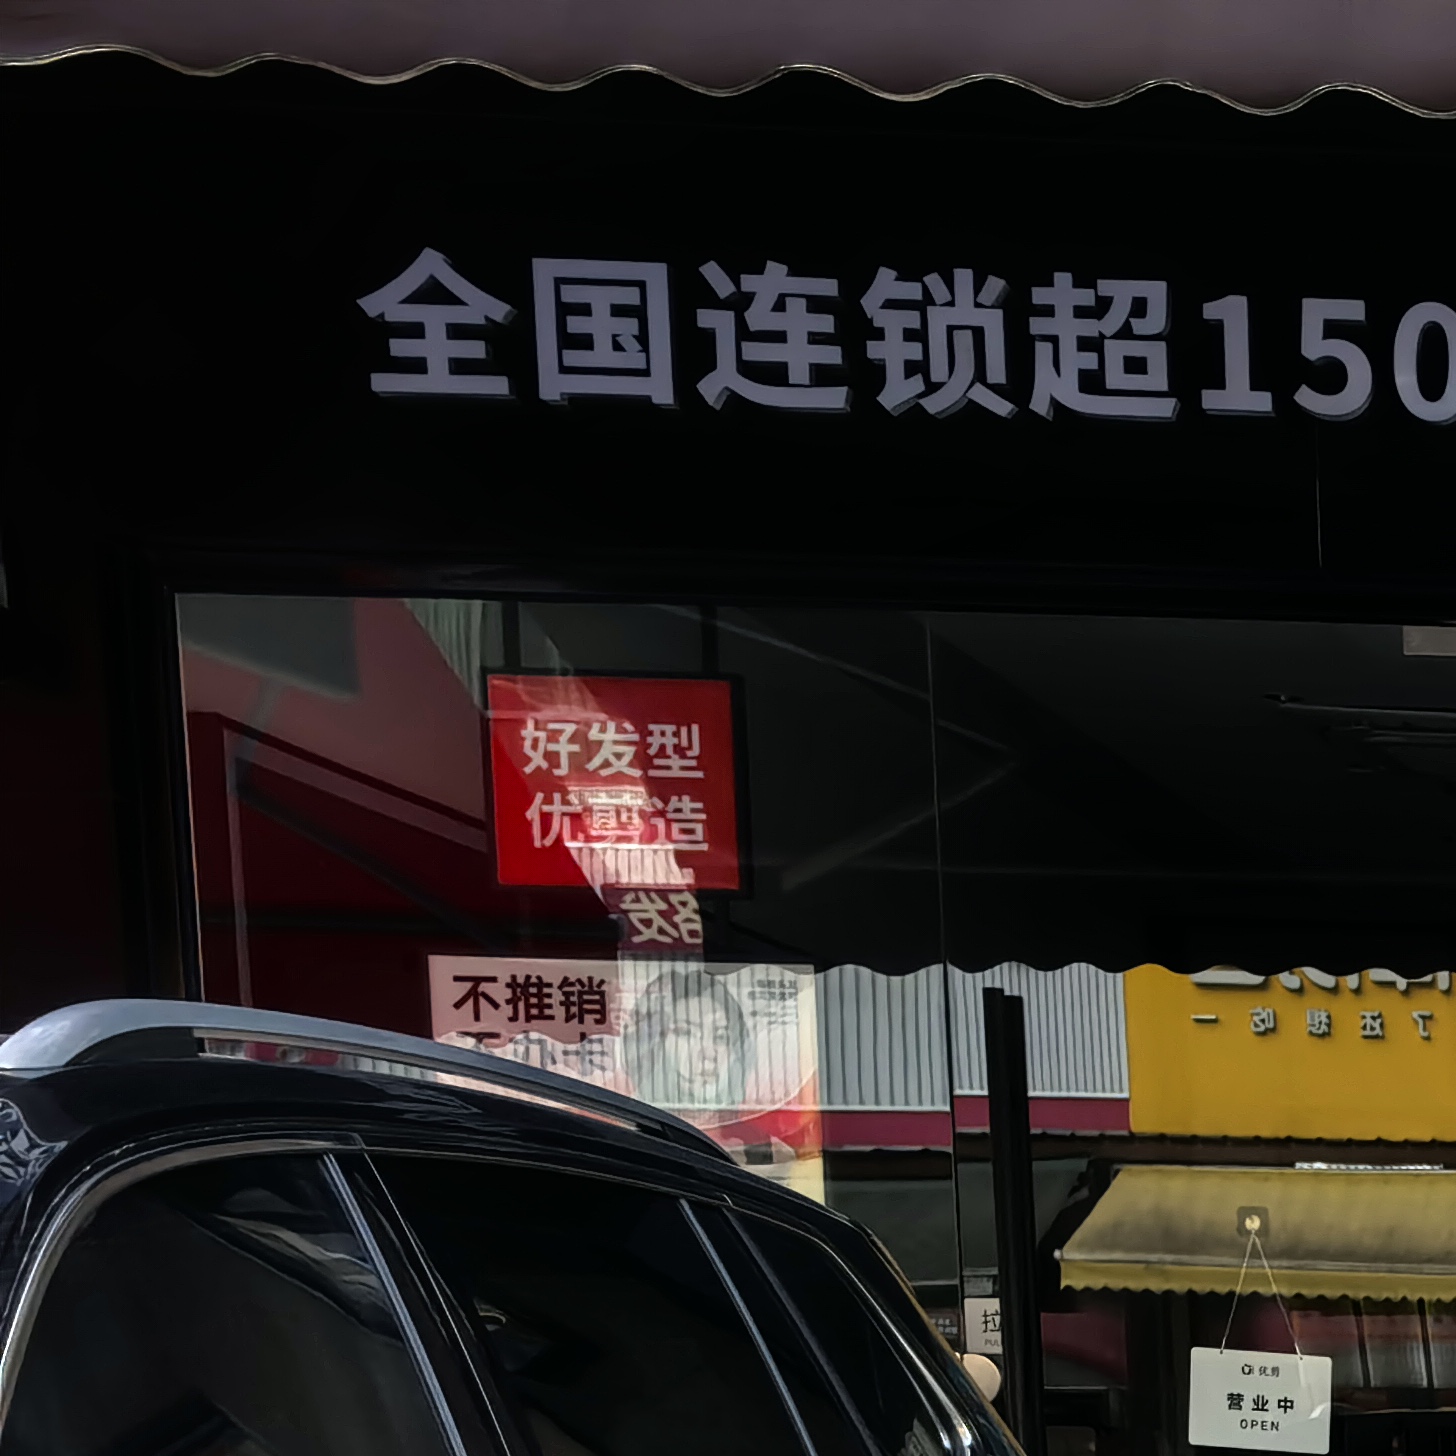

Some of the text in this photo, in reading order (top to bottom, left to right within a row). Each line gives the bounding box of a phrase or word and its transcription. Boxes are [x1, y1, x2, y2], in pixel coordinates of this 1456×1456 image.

[520, 720, 705, 780] 好发型
[452, 973, 607, 1025] 不推销
[1227, 1393, 1294, 1414] 营业中
[1240, 1419, 1280, 1431] OPEN
